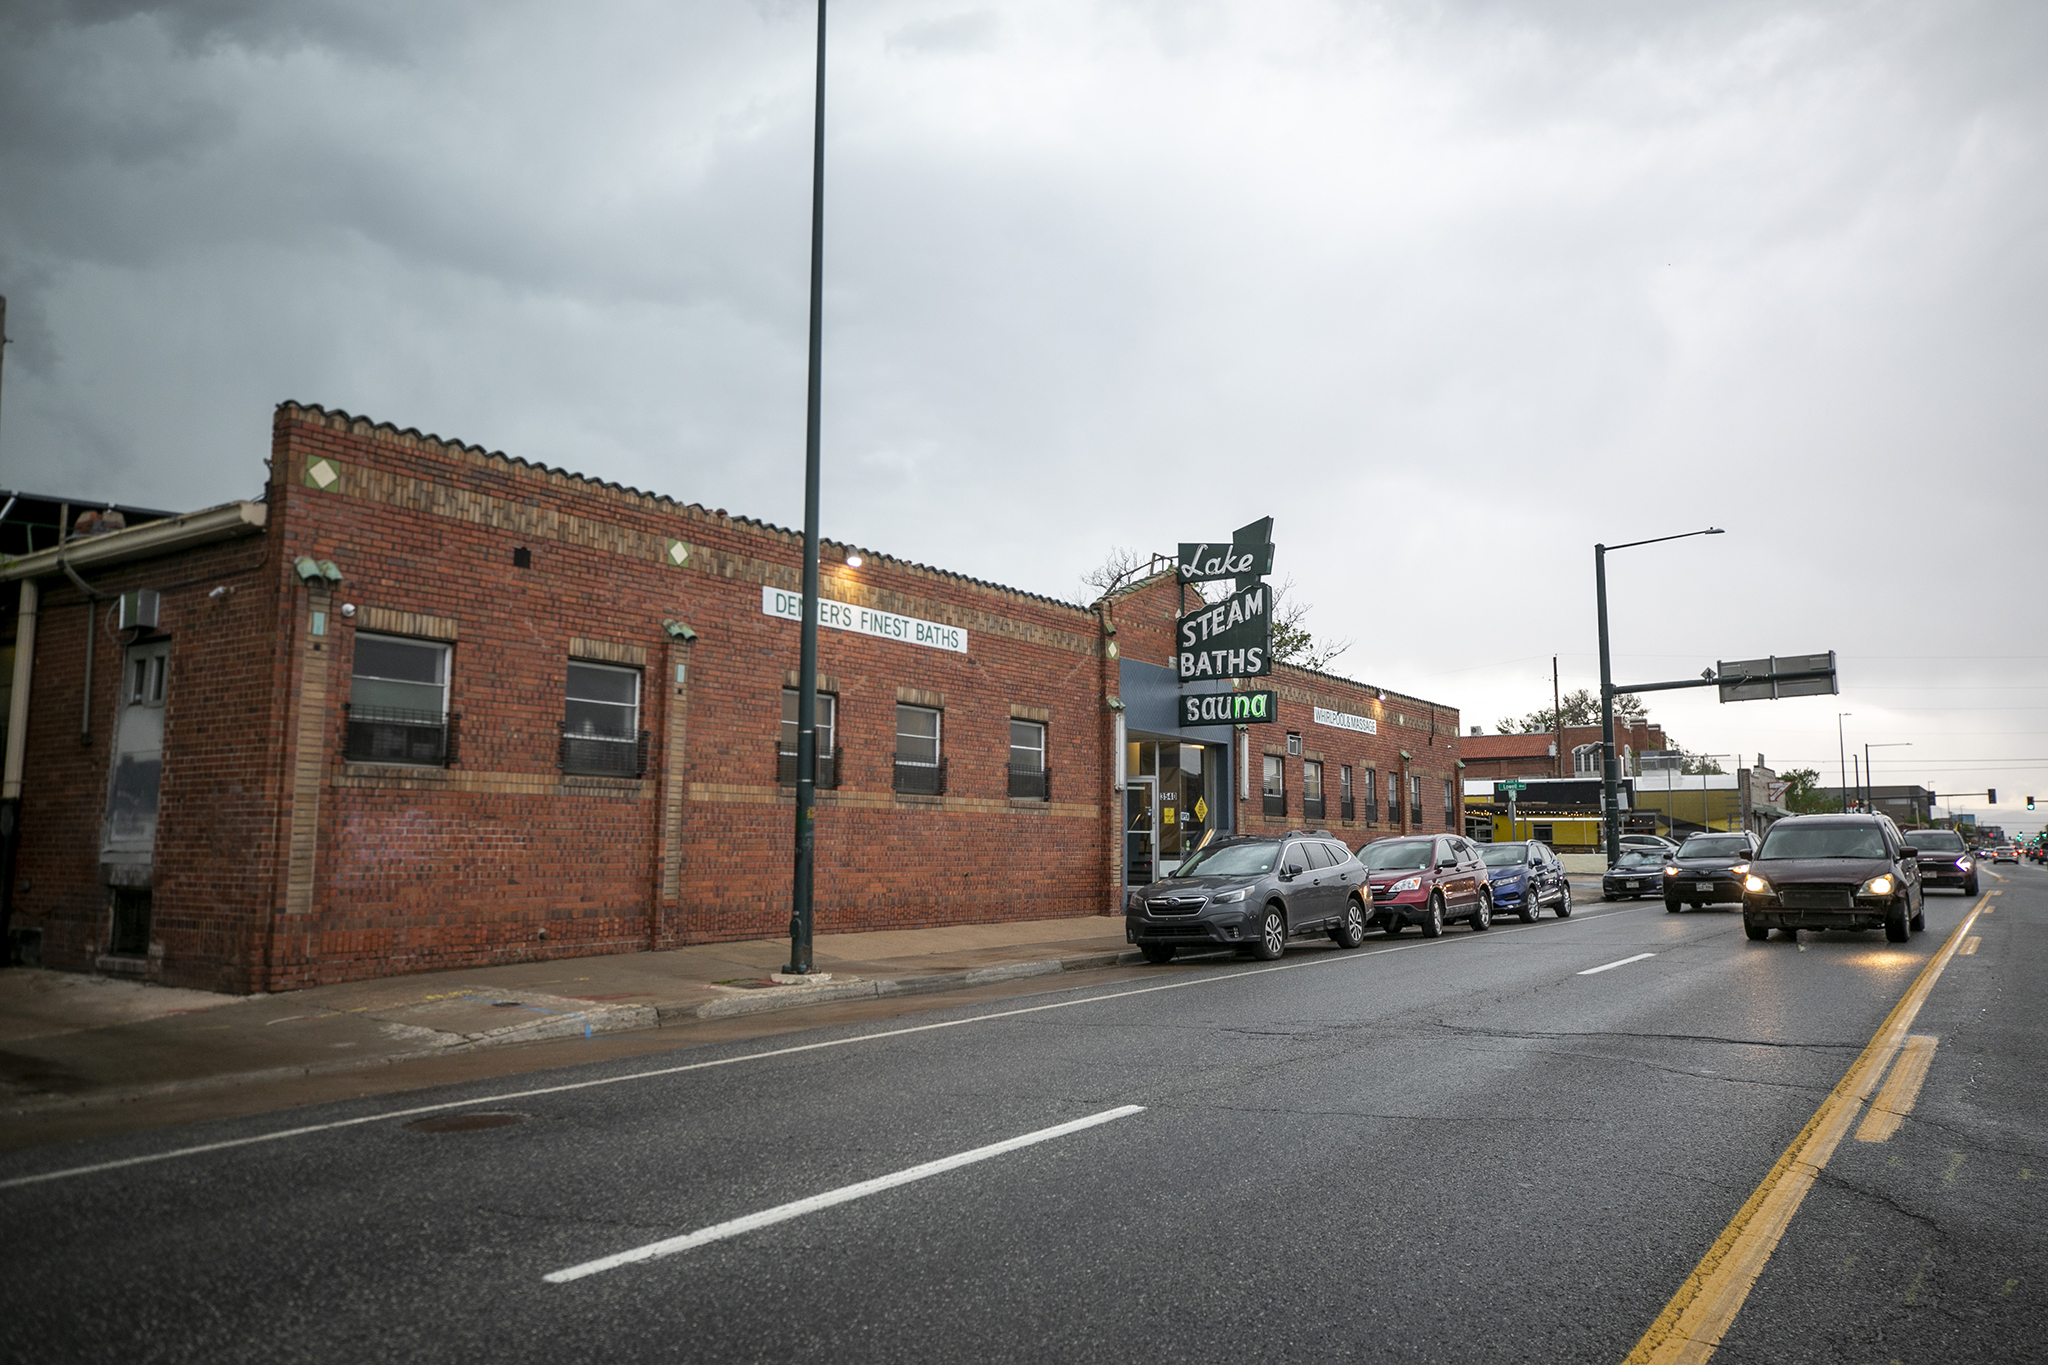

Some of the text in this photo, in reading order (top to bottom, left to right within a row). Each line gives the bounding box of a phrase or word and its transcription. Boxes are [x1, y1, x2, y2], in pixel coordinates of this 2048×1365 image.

[1181, 544, 1254, 578] Lake
[776, 593, 959, 648] DEER'S FINEST BATHS
[1182, 588, 1263, 648] STEAM
[1181, 647, 1263, 677] BATHS
[1186, 695, 1268, 721] sauna
[1315, 708, 1347, 728] WHIRLPOOL
[1351, 717, 1376, 733] MASSAGE
[1160, 792, 1177, 800] 3540
